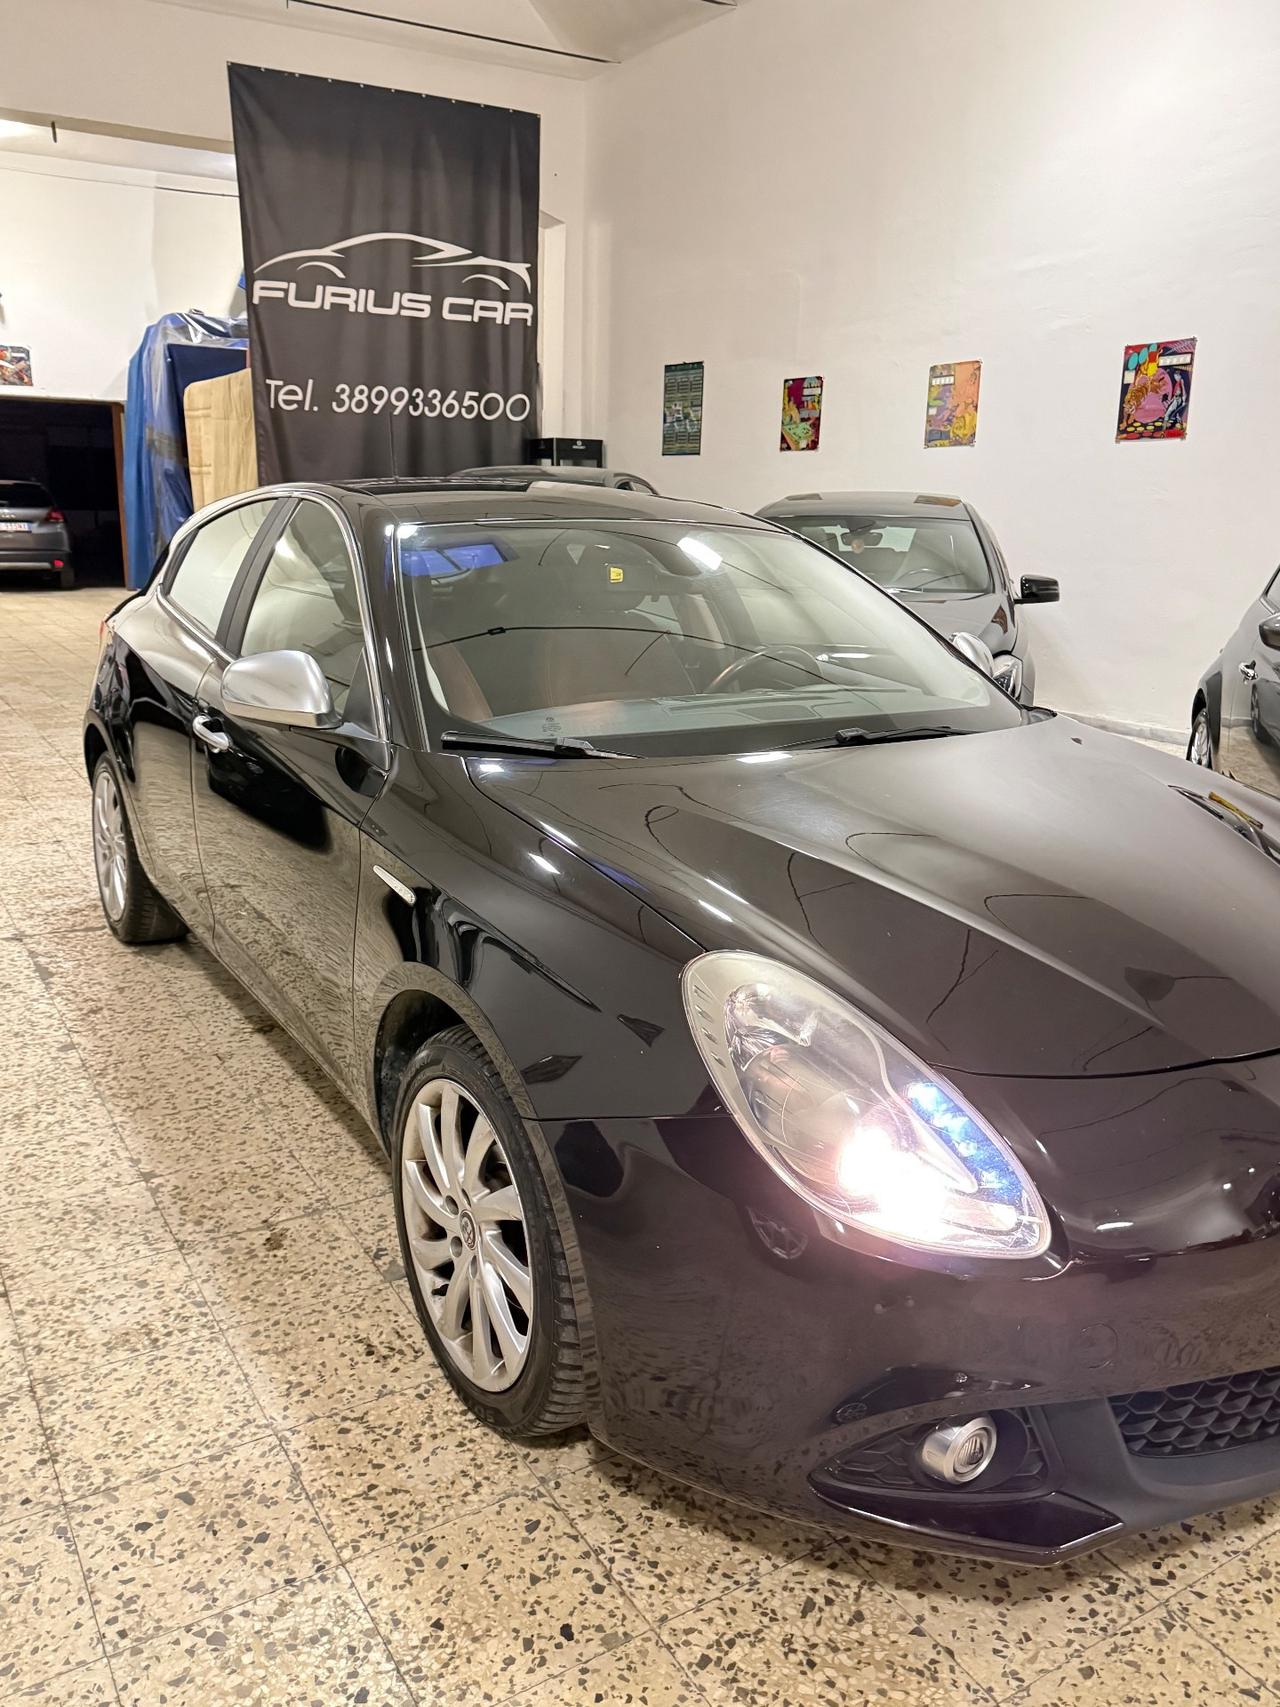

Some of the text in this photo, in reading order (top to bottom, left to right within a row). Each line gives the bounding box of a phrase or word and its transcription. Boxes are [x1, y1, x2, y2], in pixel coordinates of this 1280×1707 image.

[252, 279, 534, 327] FURIUS CAR
[265, 379, 531, 421] Tel. 3899336500
